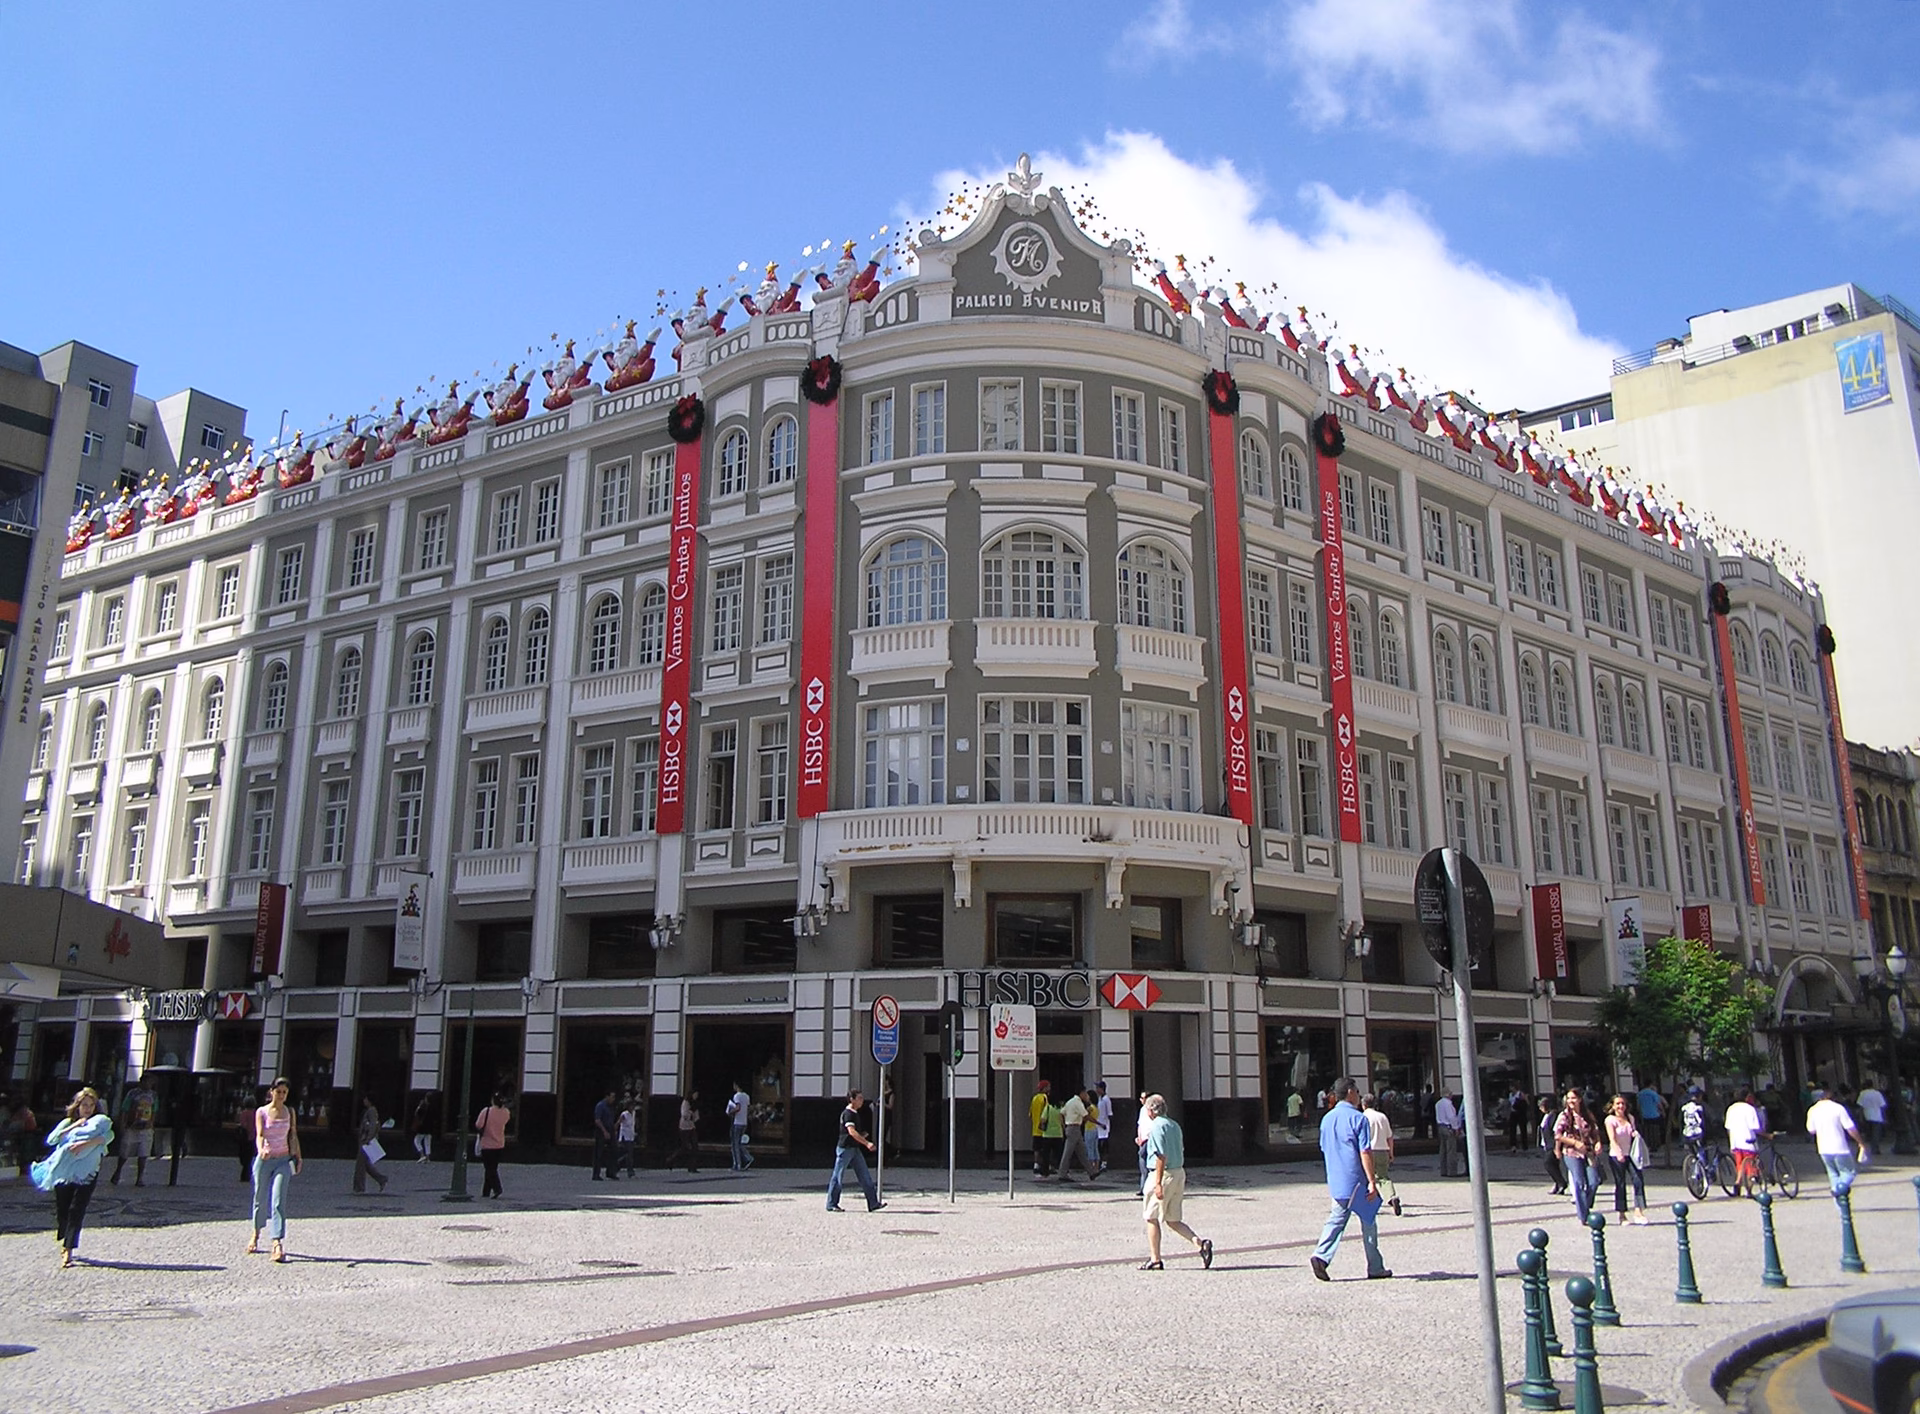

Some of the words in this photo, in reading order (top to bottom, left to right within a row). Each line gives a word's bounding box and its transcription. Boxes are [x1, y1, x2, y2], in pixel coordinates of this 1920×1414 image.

[955, 294, 1012, 309] PALACIO
[1021, 292, 1103, 315] AVENIDA
[1843, 349, 1881, 391] 44
[674, 472, 694, 532] Juntos
[1323, 491, 1341, 551] Juntos
[671, 536, 691, 601] Cantar
[1328, 553, 1343, 617] Cantar
[666, 605, 684, 673] Vamos
[1332, 620, 1346, 684] Vamos
[662, 739, 682, 804] HSBC
[804, 717, 824, 787] HSBC
[1230, 726, 1247, 793] HSBC
[1340, 751, 1356, 814] HSBC
[1748, 839, 1761, 884] HSBC
[1854, 859, 1866, 901] HSBC
[260, 911, 269, 926] DO
[261, 885, 271, 910] HSBC
[1549, 887, 1560, 913] HSBC
[1551, 914, 1562, 928] DO
[1699, 907, 1710, 931] HSBC
[255, 928, 268, 955] NATAL
[1553, 930, 1565, 960] NATAL
[157, 989, 220, 1020] HSBC
[953, 971, 1091, 1011] HSBC
